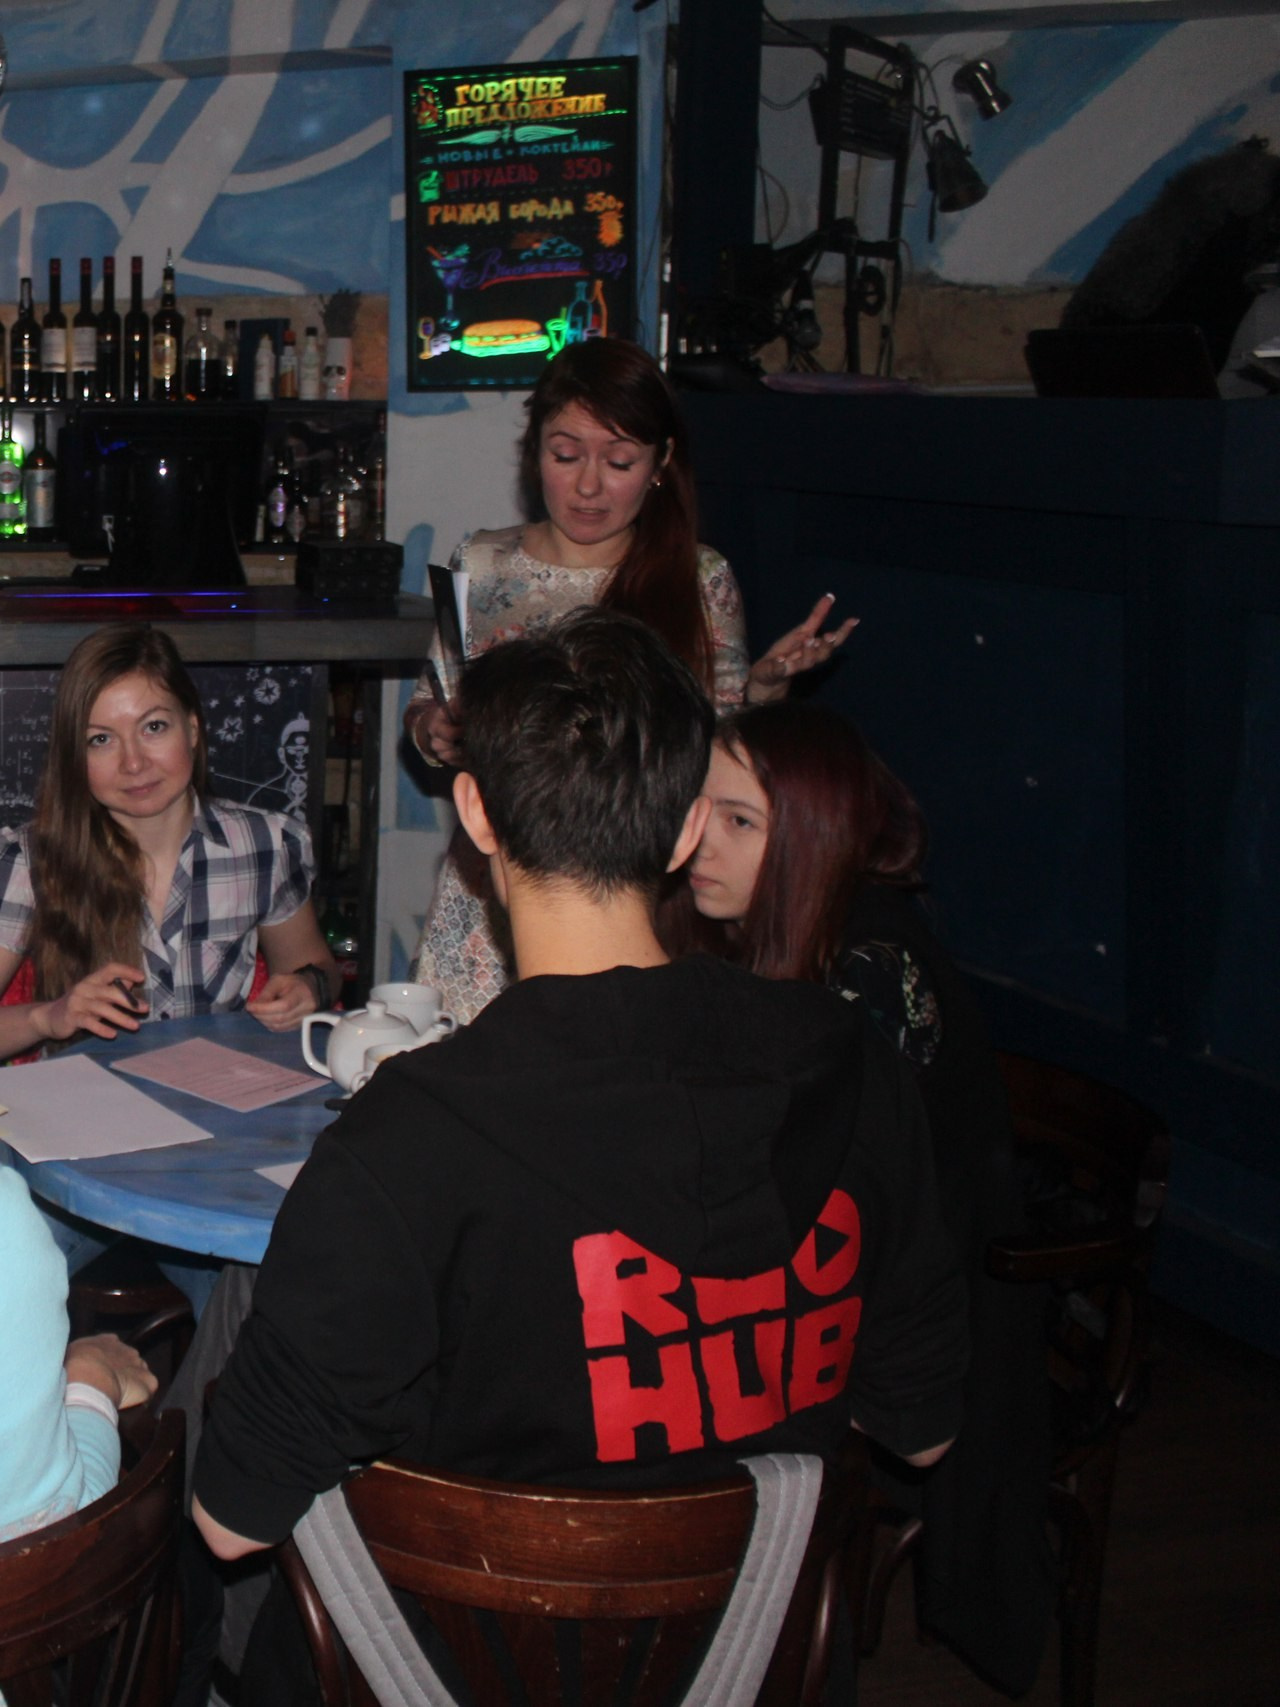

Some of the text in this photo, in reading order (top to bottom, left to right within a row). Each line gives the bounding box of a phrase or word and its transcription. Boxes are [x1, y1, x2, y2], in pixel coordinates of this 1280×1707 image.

[455, 76, 567, 106] ГОРЯЧЕЕ
[445, 93, 607, 128] ПРЕДЛОЖЕНИЕ
[437, 134, 602, 164] НОВЫЕ КОКТЕЙЛИ
[428, 201, 501, 225] РЫЖАЯ
[587, 1296, 862, 1462] HUB
